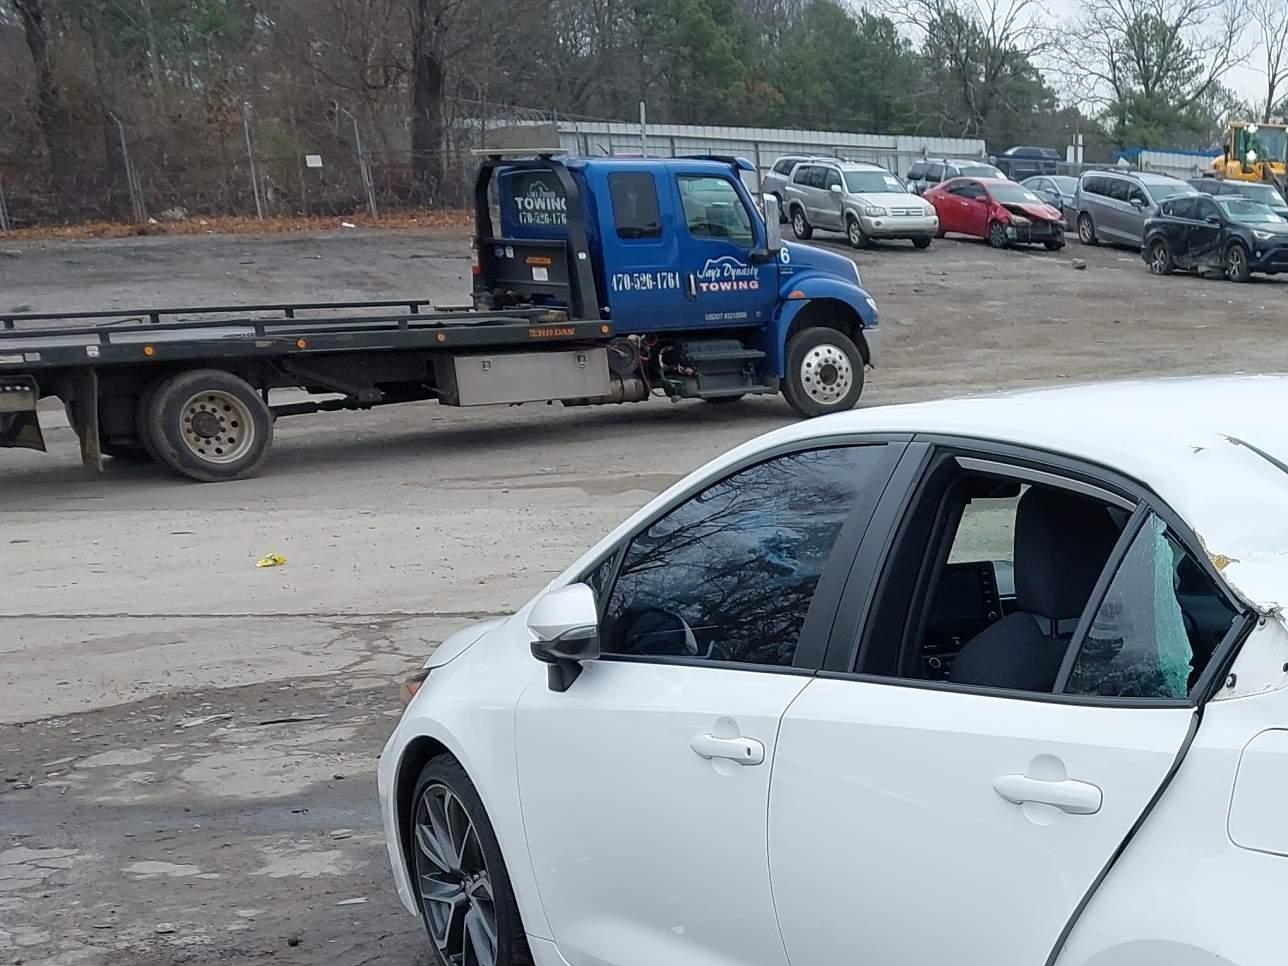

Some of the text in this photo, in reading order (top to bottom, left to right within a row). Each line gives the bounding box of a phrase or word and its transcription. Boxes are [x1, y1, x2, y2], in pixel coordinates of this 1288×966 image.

[780, 247, 791, 264] 6
[722, 263, 759, 281] Dynasty
[699, 280, 759, 292] TOWING
